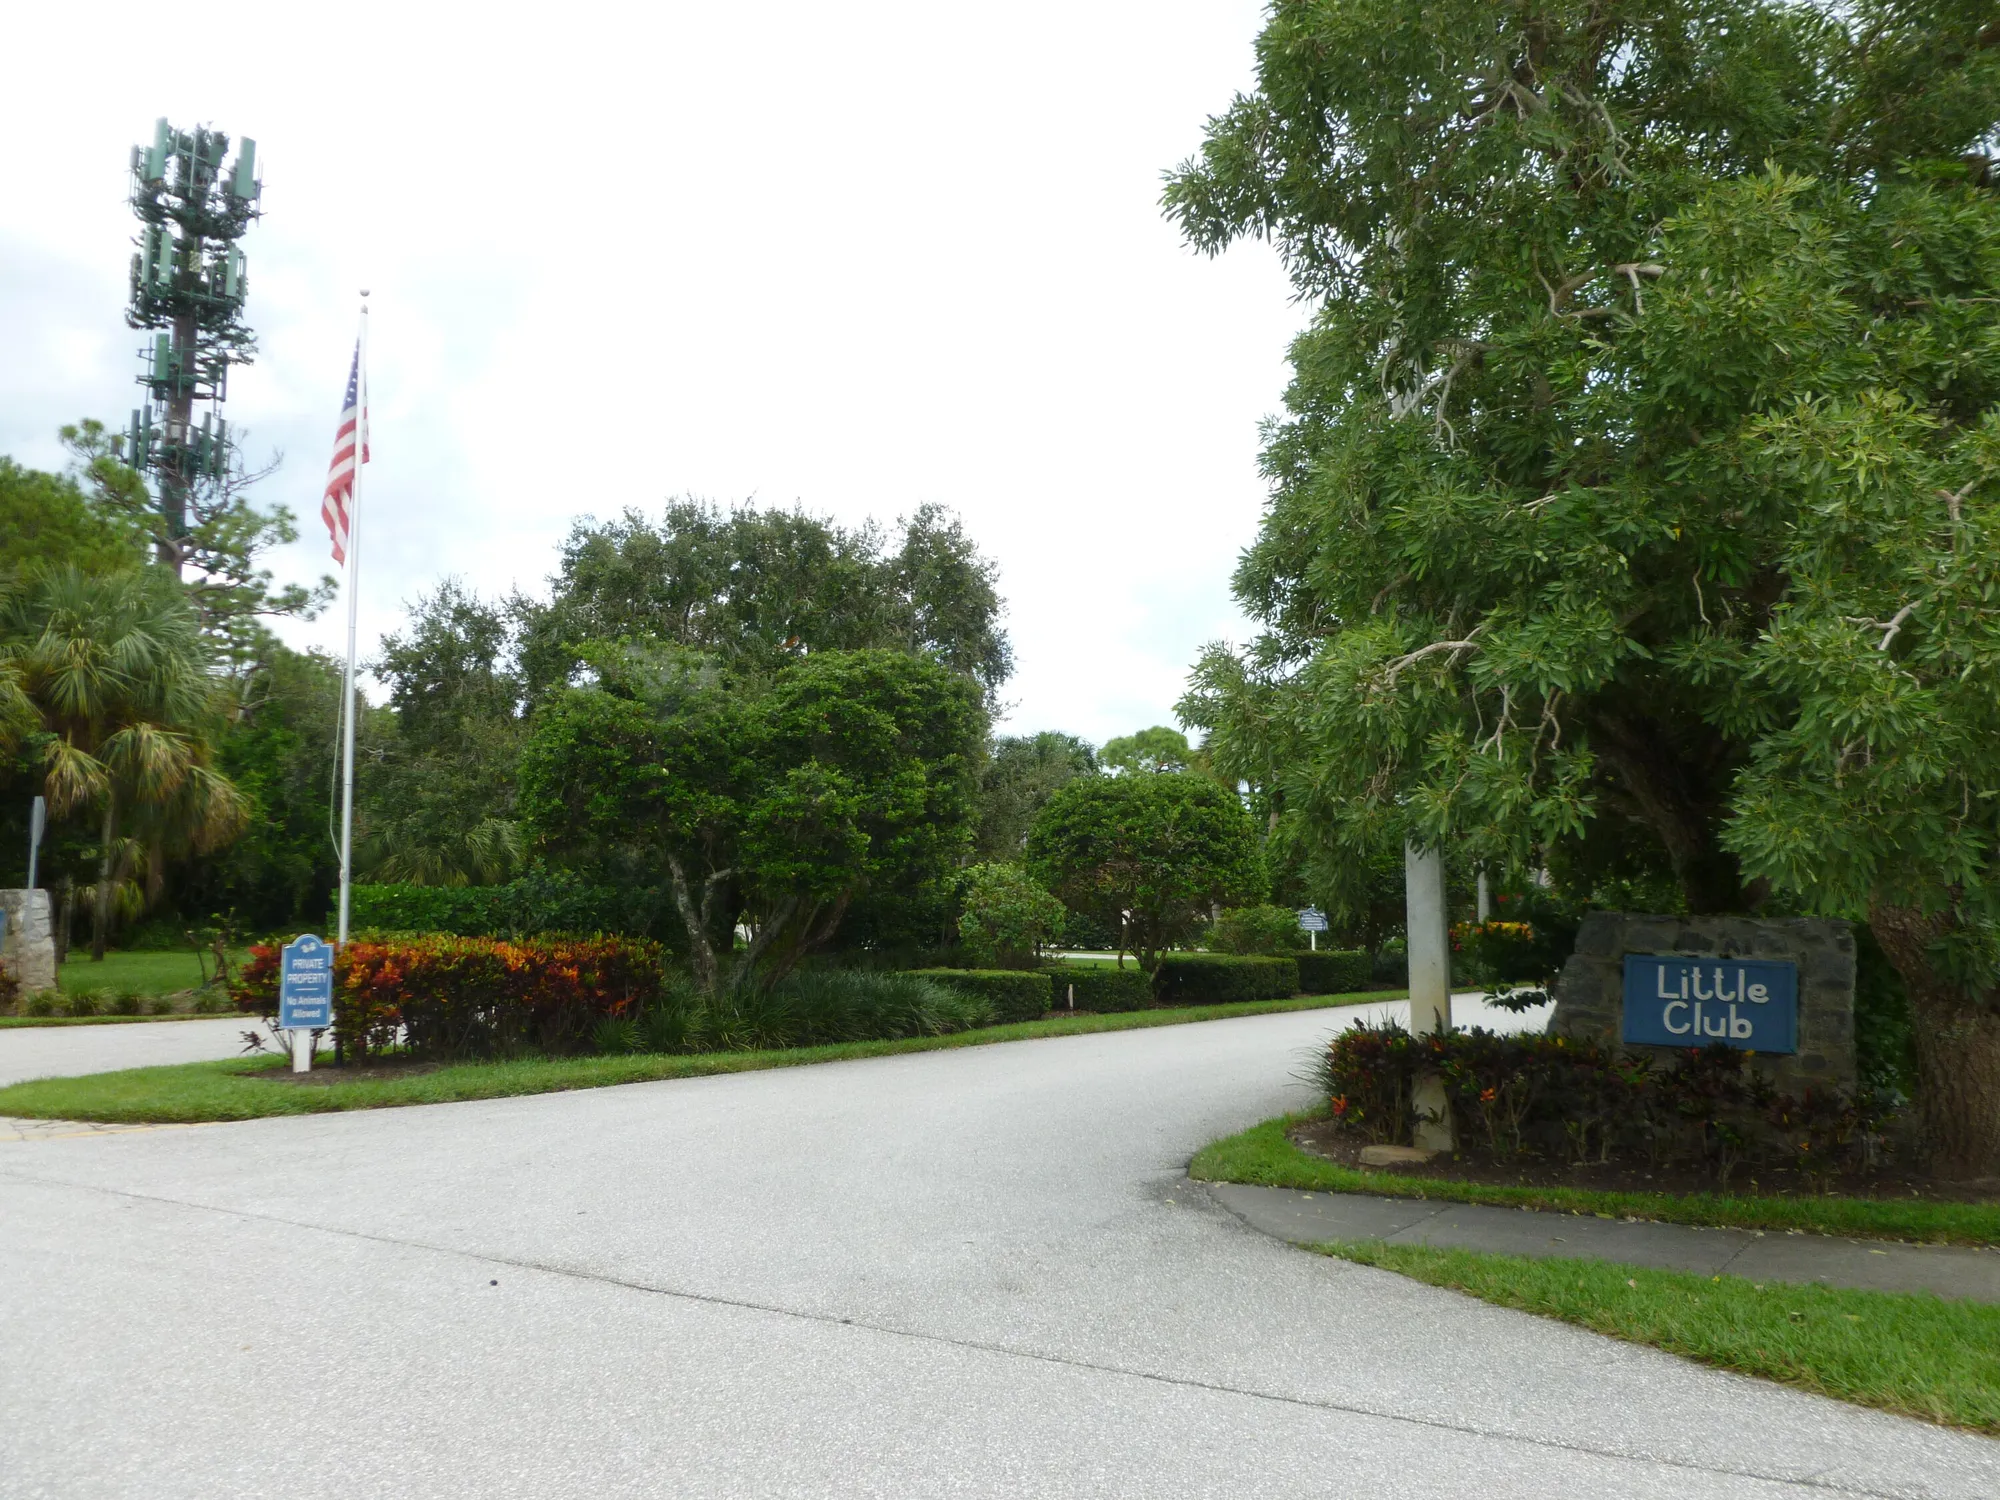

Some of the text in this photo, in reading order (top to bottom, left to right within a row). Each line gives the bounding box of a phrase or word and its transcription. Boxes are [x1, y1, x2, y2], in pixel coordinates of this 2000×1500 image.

[293, 959, 324, 969] PRIVATE
[287, 974, 327, 984] PROPERTY
[1657, 965, 1770, 1004] Little
[287, 996, 326, 1005] No Animals
[292, 1009, 320, 1018] Allowed
[1663, 1001, 1753, 1039] Club
